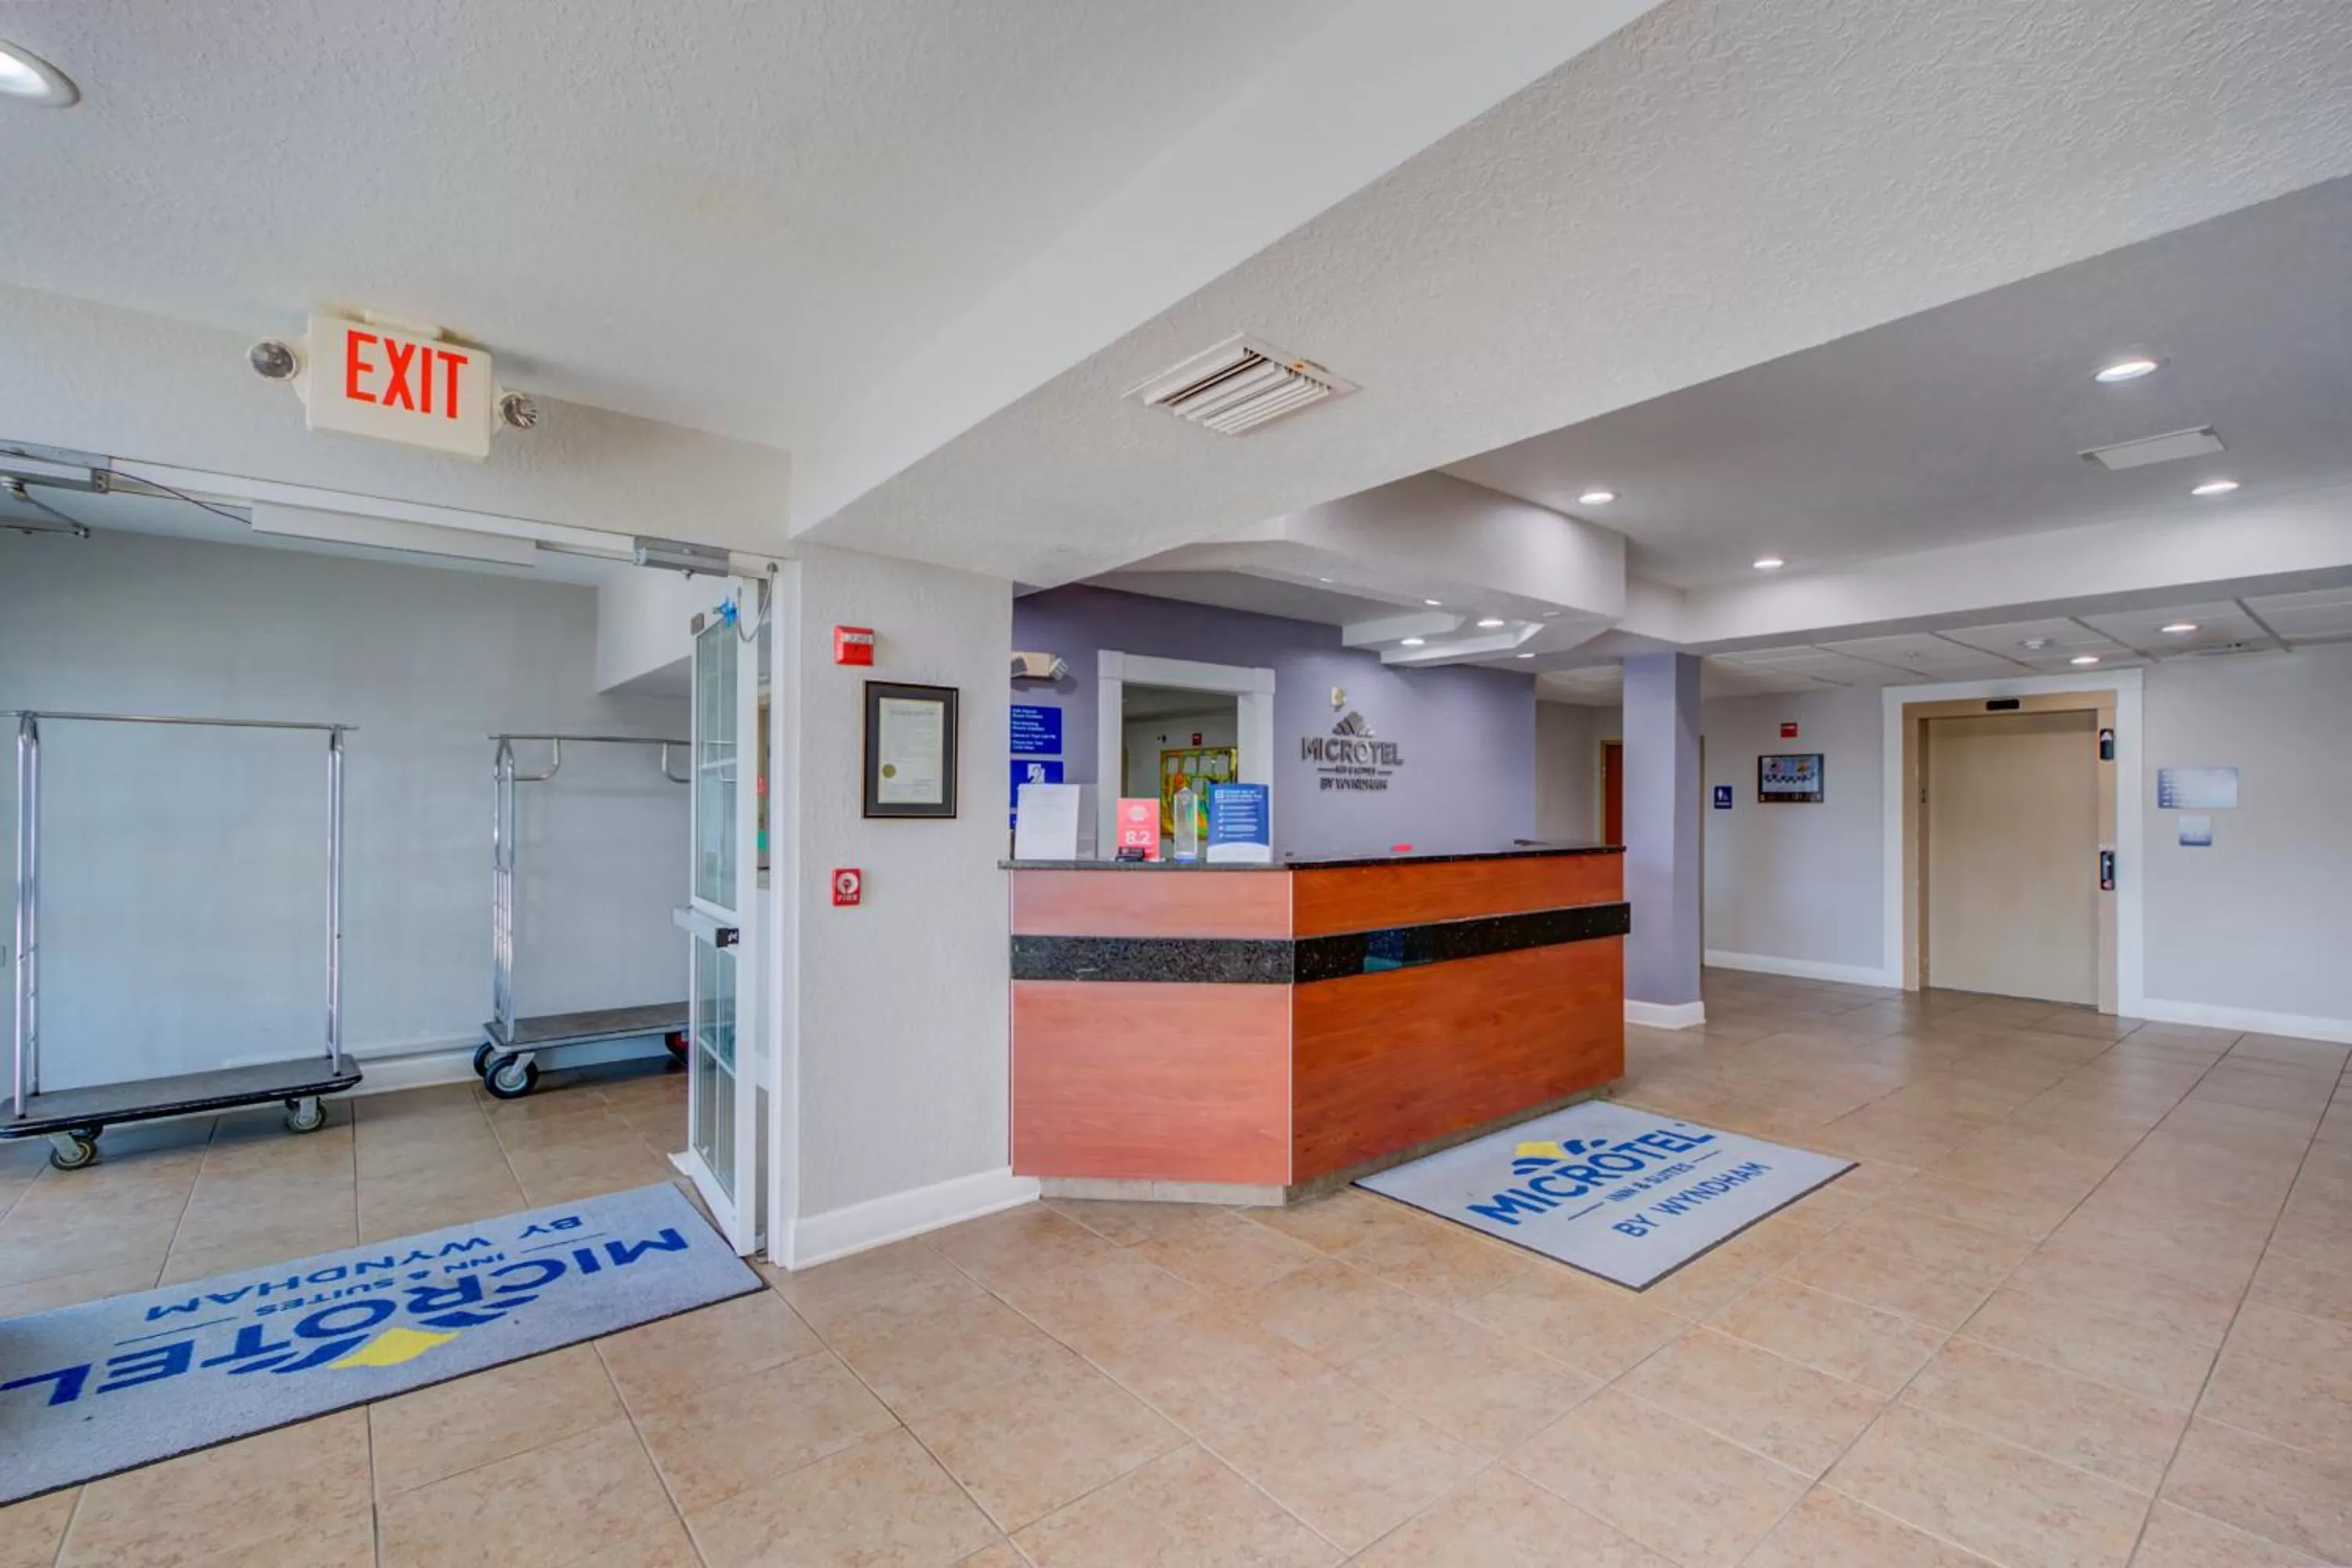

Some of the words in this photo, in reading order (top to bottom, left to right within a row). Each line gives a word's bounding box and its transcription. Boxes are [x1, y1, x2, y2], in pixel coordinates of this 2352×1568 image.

[347, 328, 468, 419] EXIT
[1301, 736, 1404, 766] MICROTEL
[1466, 1130, 1716, 1225] MICROTEL
[1606, 1185, 1635, 1202] INN
[1633, 1181, 1652, 1190] &
[1646, 1162, 1694, 1187] SUITES
[1612, 1213, 1660, 1238] BY
[1650, 1161, 1773, 1217] WYNDHAM
[518, 1215, 584, 1240] BY
[144, 1236, 492, 1323] WYNDHAM
[408, 1269, 433, 1281] &
[444, 1252, 505, 1275] INN
[0, 1228, 689, 1406] MICROTEL
[254, 1278, 394, 1316] SUITES
